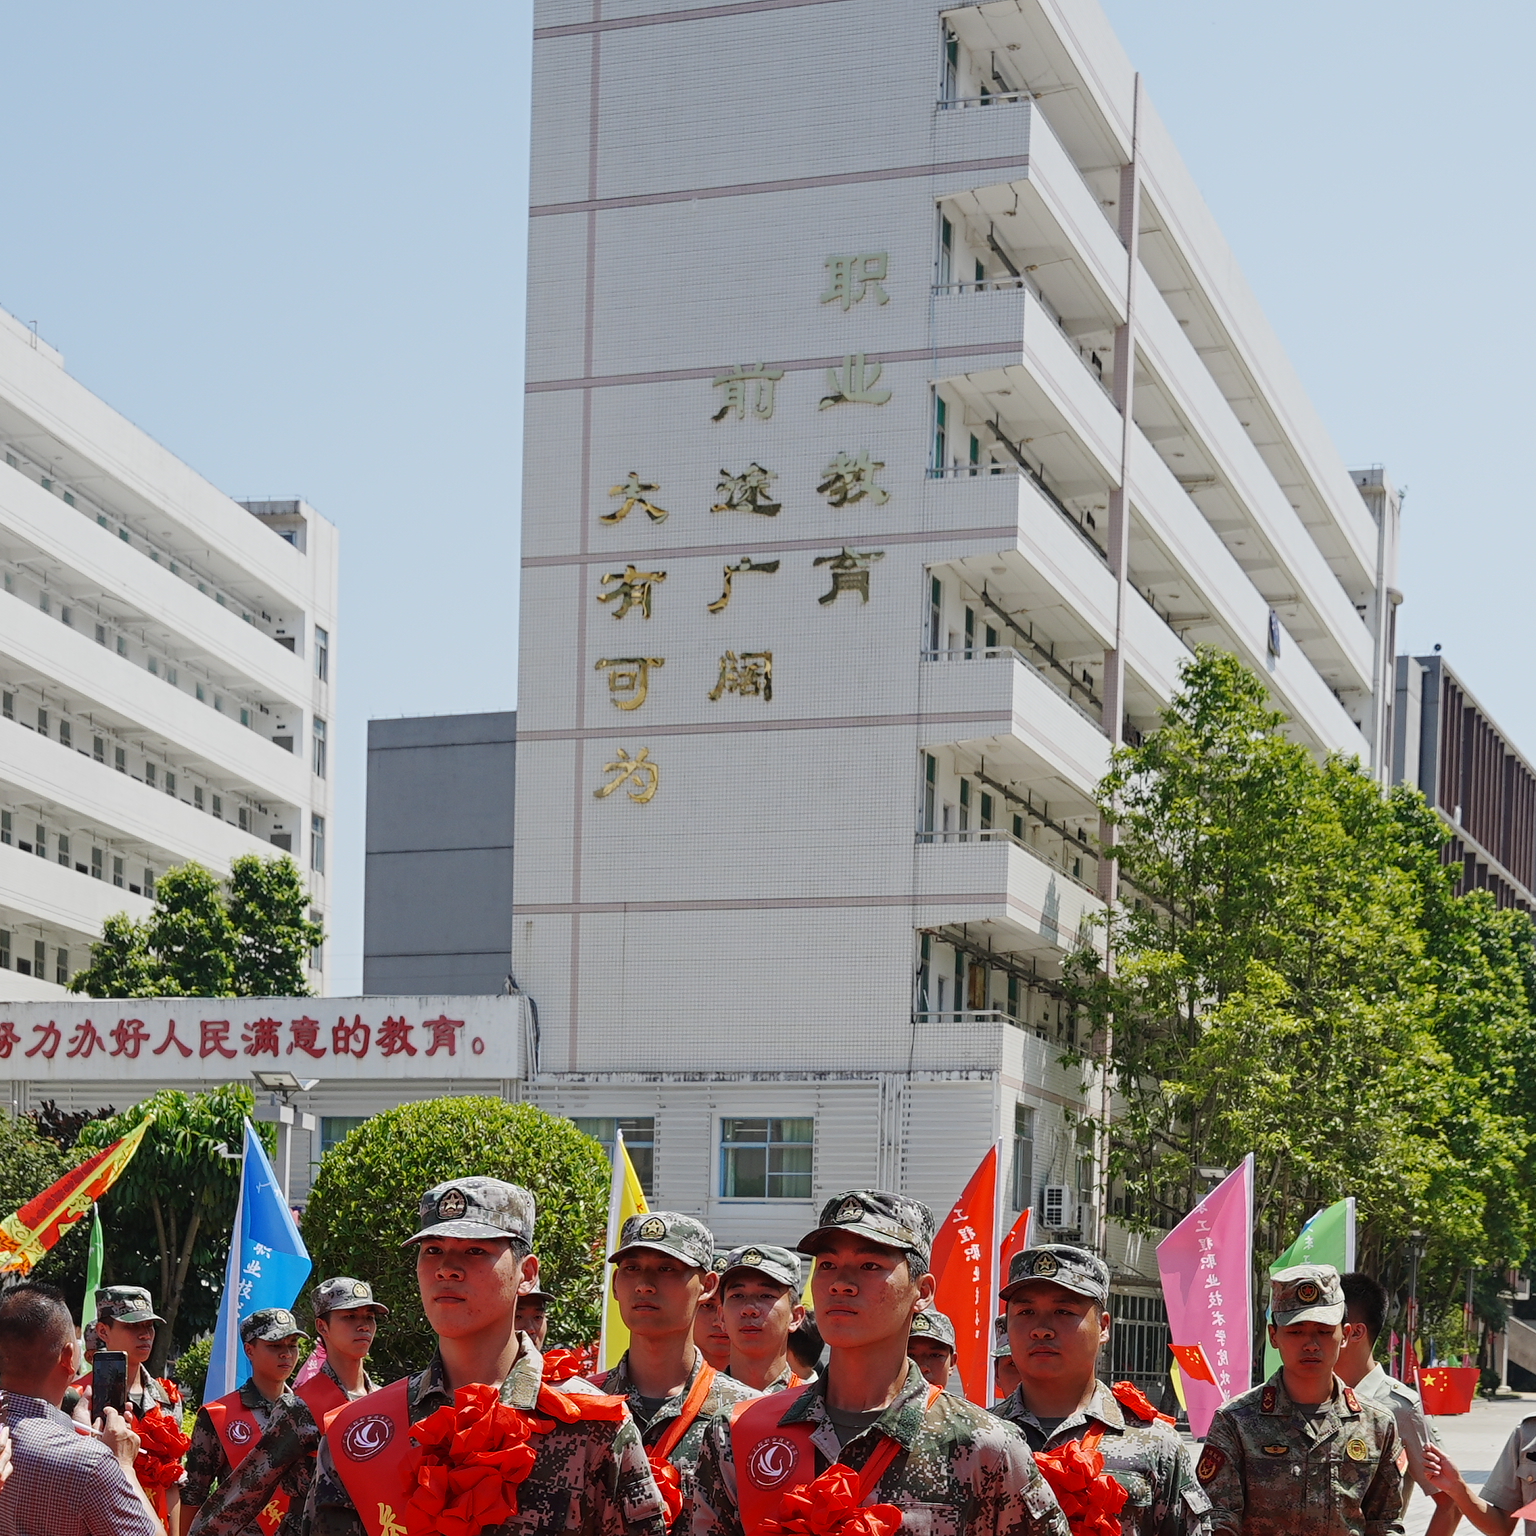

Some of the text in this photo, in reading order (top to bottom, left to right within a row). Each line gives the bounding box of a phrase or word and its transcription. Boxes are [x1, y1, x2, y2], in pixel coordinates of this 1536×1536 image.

[707, 361, 784, 702] 前途广阔
[812, 250, 893, 607] 职业教育
[593, 471, 669, 804] 大有可为
